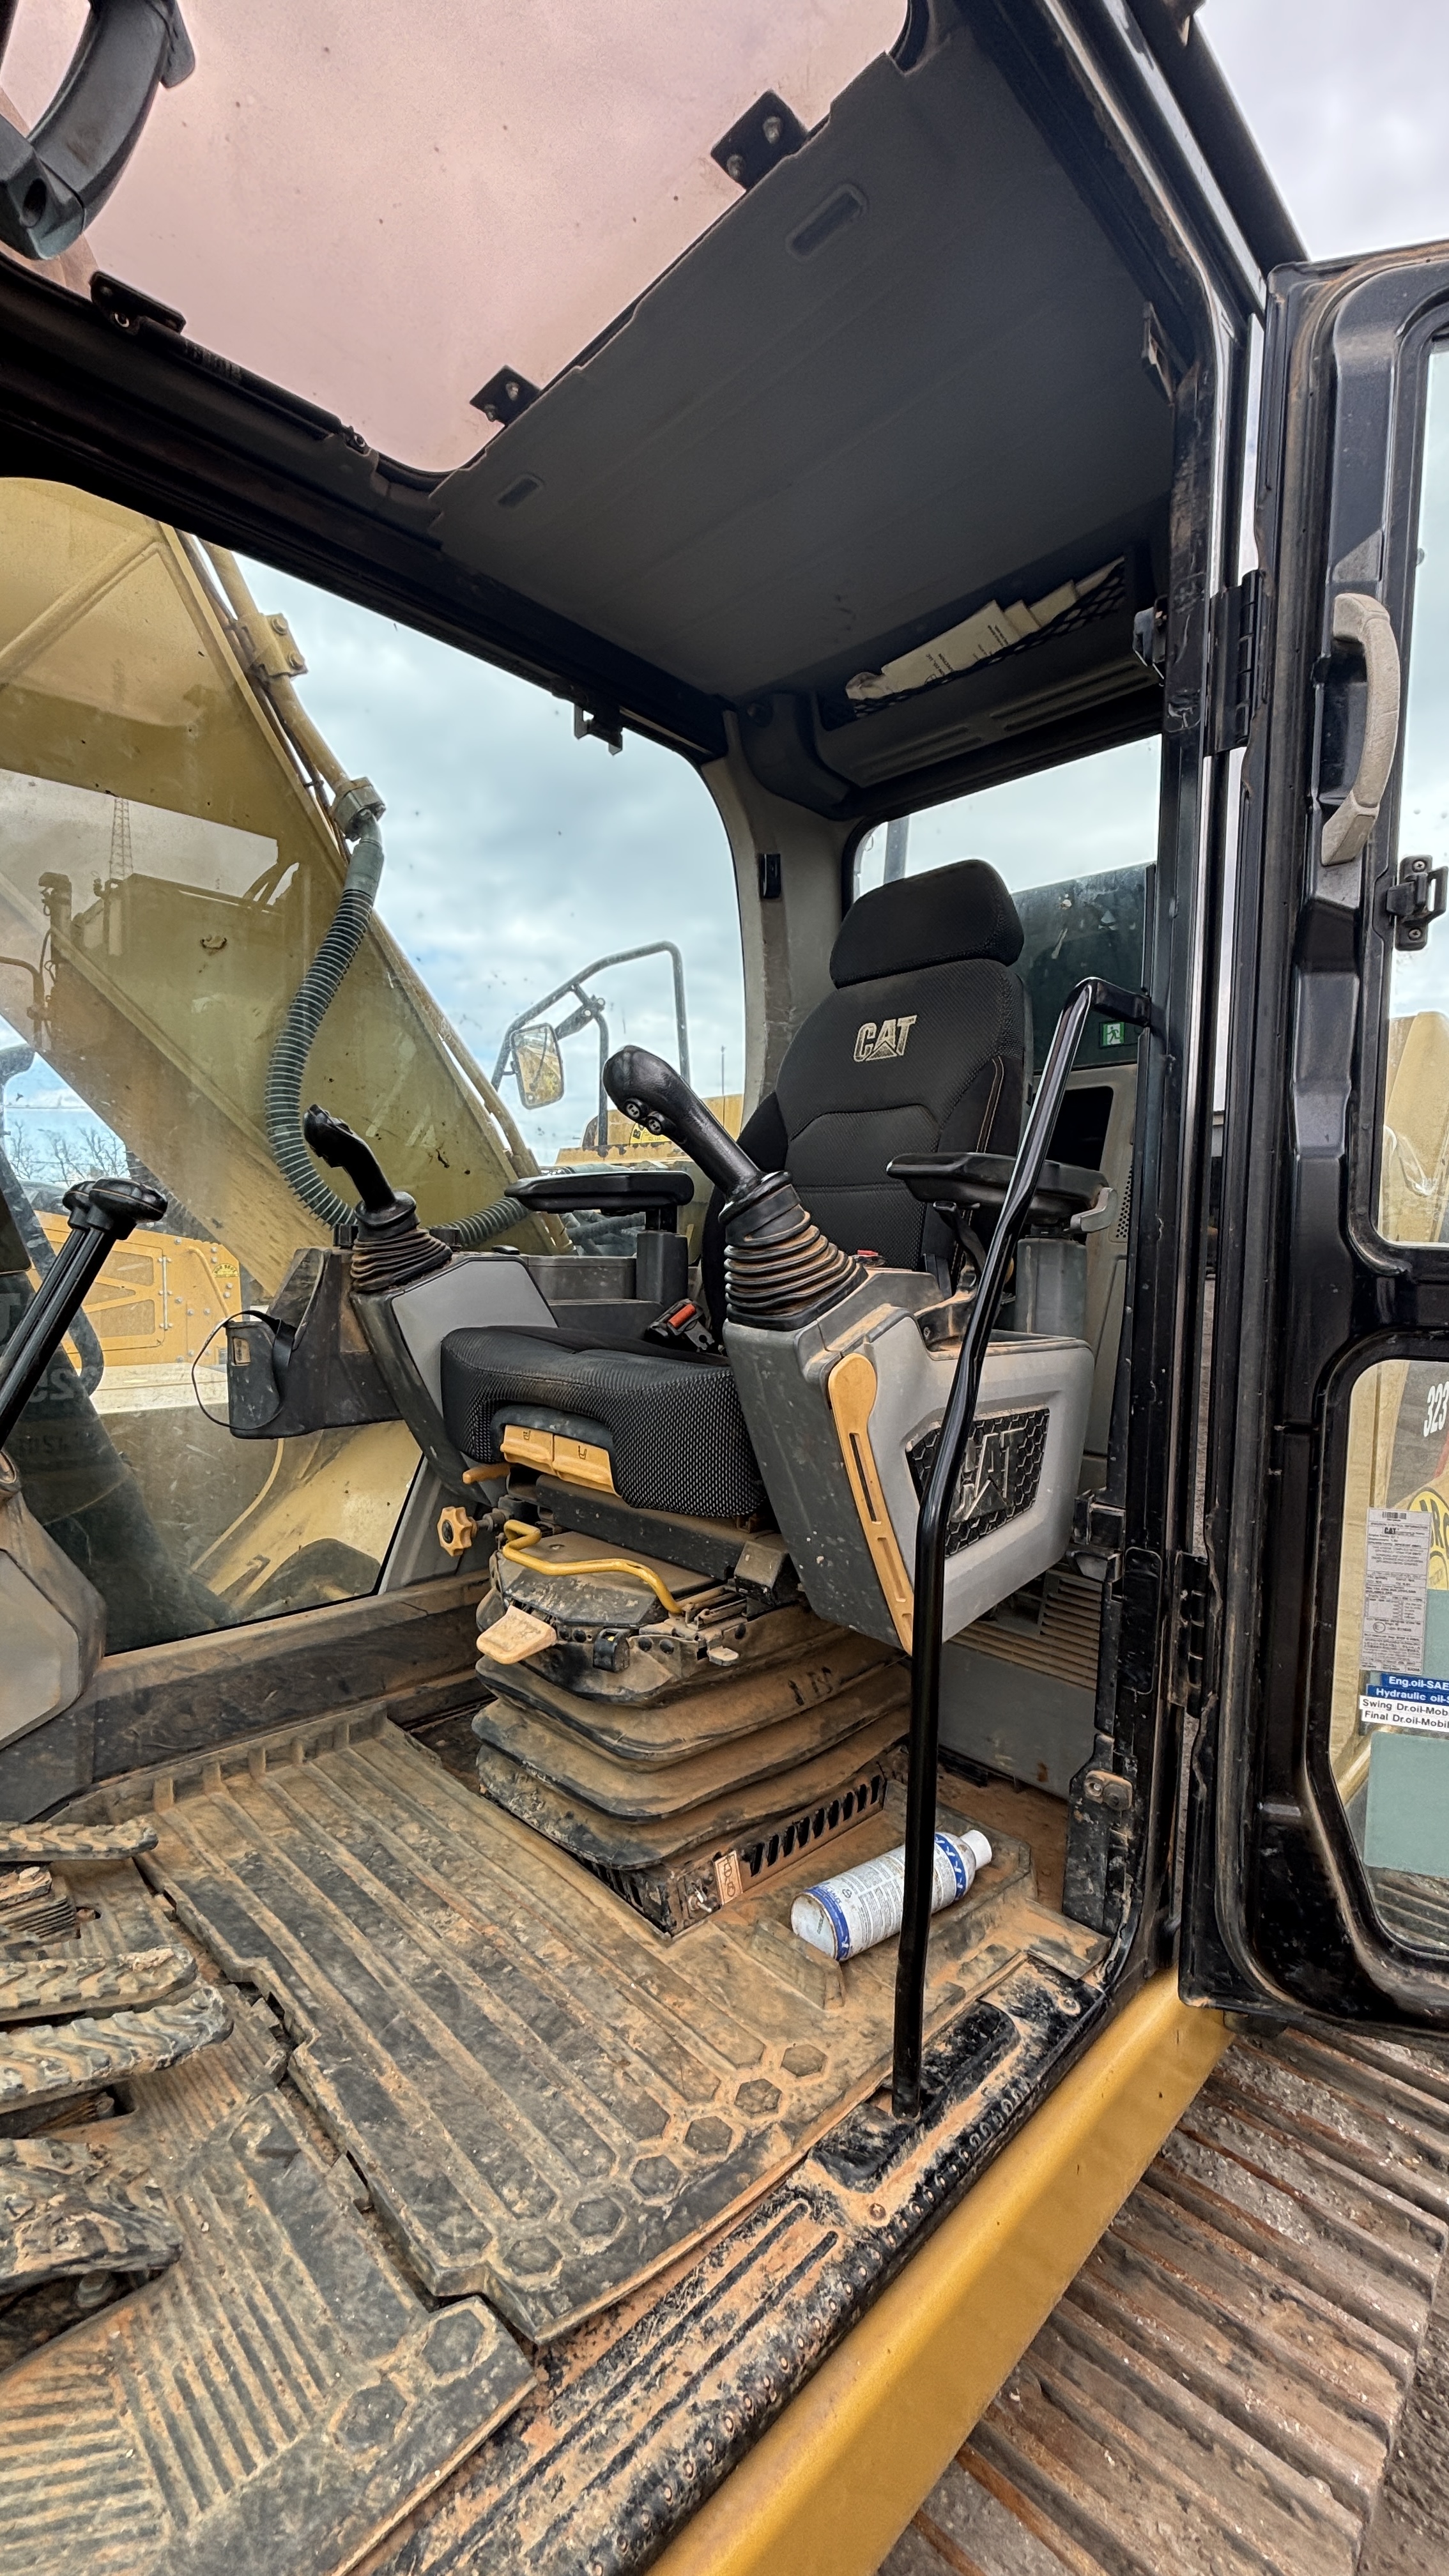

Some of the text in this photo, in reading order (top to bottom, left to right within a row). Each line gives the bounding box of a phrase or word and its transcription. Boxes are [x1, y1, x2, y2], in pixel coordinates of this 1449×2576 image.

[854, 1015, 917, 1062] CAT
[1384, 1526, 1397, 1535] CAT
[1388, 1676, 1449, 1690] Eng.oil-SAE
[1376, 1687, 1426, 1701] Hydraulic
[1363, 1699, 1449, 1716] Swing Dr.oil-Mob
[1365, 1710, 1388, 1721] Final
